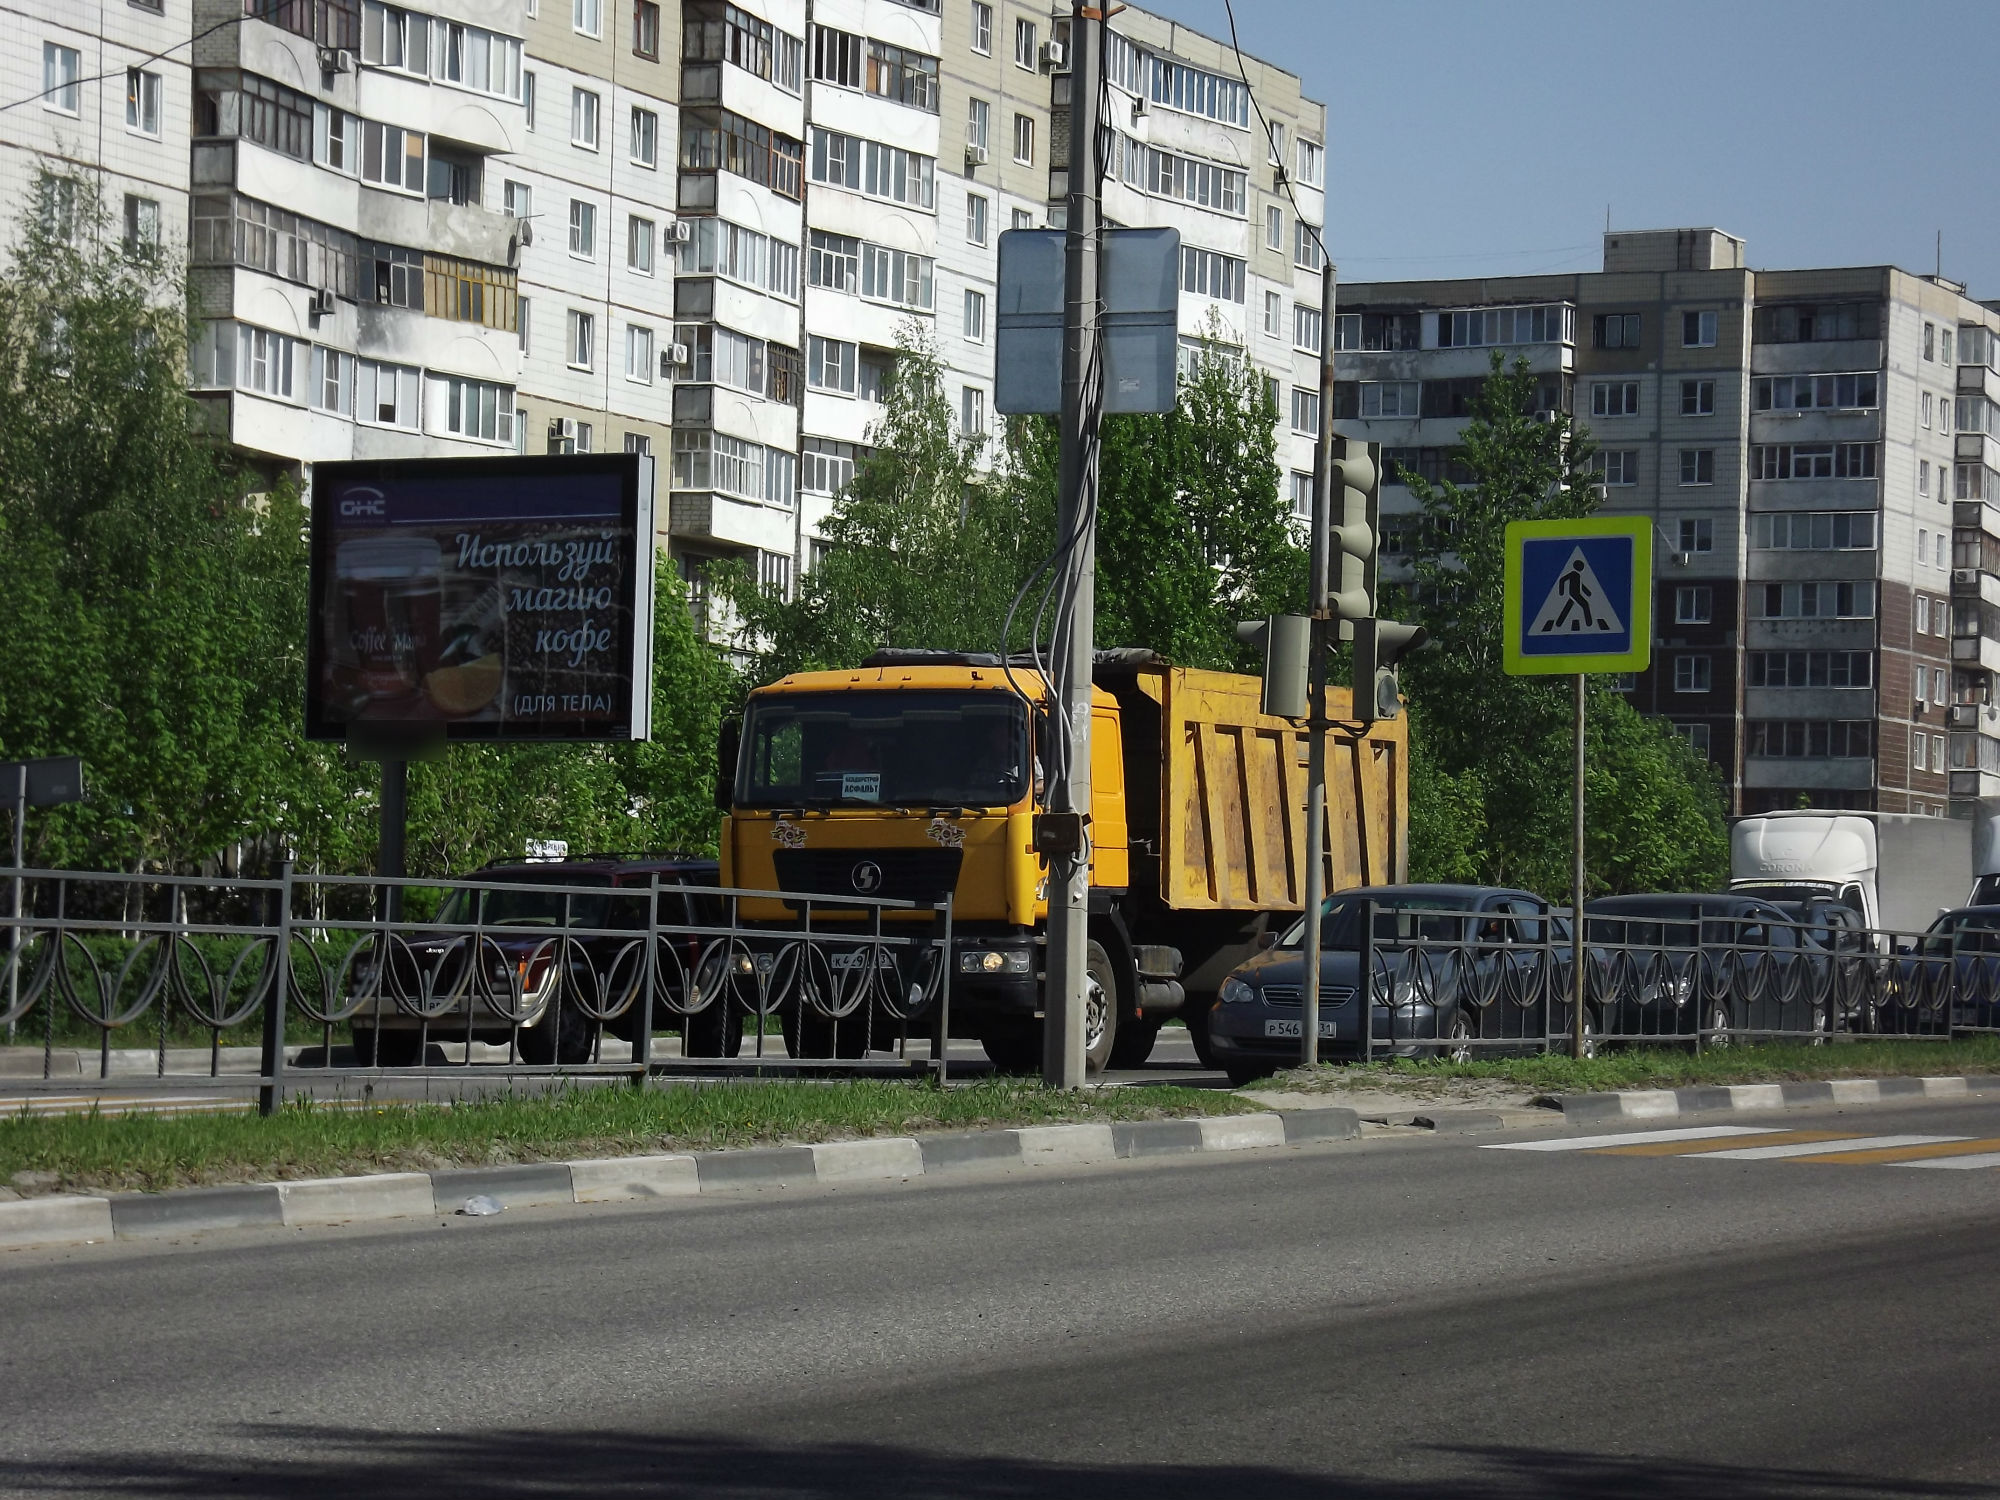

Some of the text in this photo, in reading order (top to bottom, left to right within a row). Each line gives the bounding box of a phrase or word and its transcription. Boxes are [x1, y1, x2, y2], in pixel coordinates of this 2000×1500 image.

[455, 531, 615, 581] Используй
[506, 584, 612, 613] магию
[535, 618, 612, 667] кофе
[513, 693, 612, 715] (ДЛЯ ТЕЛА)
[844, 784, 878, 793] АСФАЛЬТ
